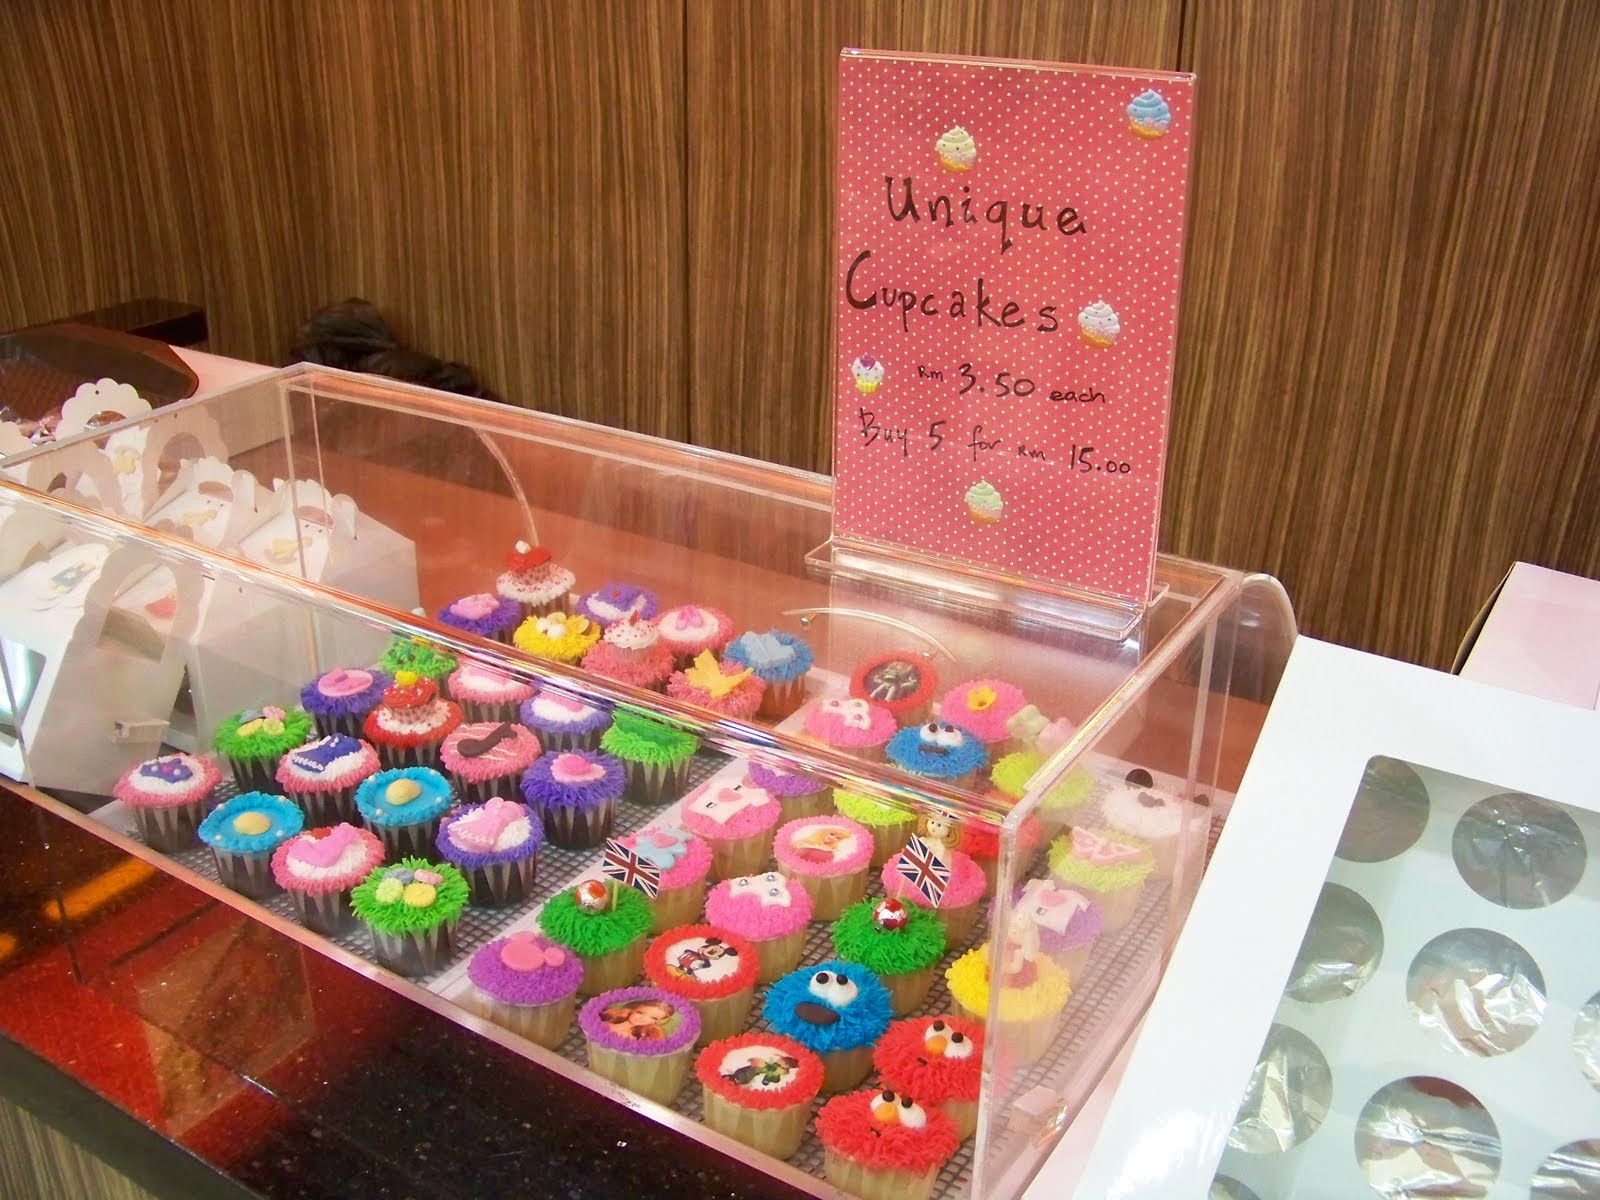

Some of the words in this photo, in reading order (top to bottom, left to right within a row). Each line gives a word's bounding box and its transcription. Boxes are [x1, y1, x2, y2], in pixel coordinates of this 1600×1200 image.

[884, 175, 1087, 255] Unique
[845, 250, 1059, 333] Cupcakes
[958, 363, 1036, 397] 3.50
[1049, 387, 1106, 403] each
[859, 407, 908, 457] Buy
[929, 420, 946, 450] 5
[967, 424, 1002, 462] for
[1071, 444, 1131, 473] 15.00
